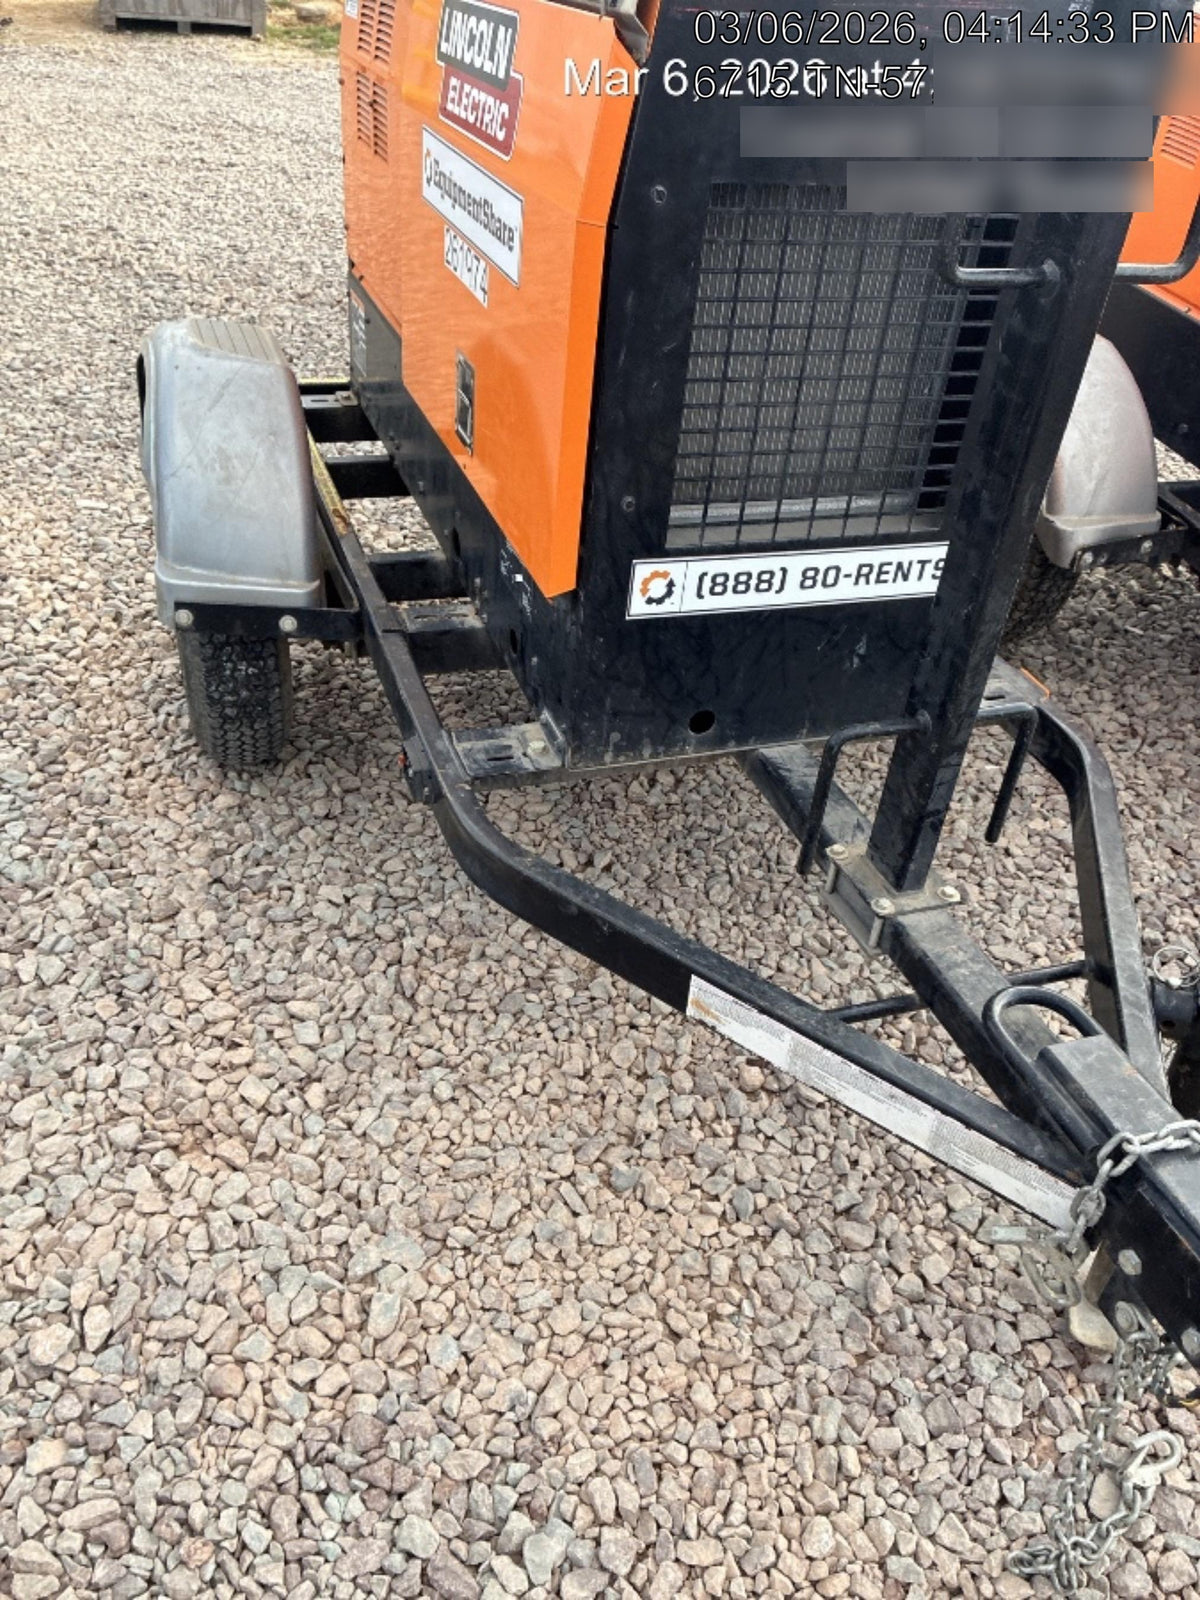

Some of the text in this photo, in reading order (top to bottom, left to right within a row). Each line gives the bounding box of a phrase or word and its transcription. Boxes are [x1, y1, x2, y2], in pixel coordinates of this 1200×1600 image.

[440, 7, 513, 80] LINCOLN
[446, 76, 509, 141] ELECTRIC
[433, 157, 515, 252] EquipmentShare
[696, 567, 788, 599] (888)
